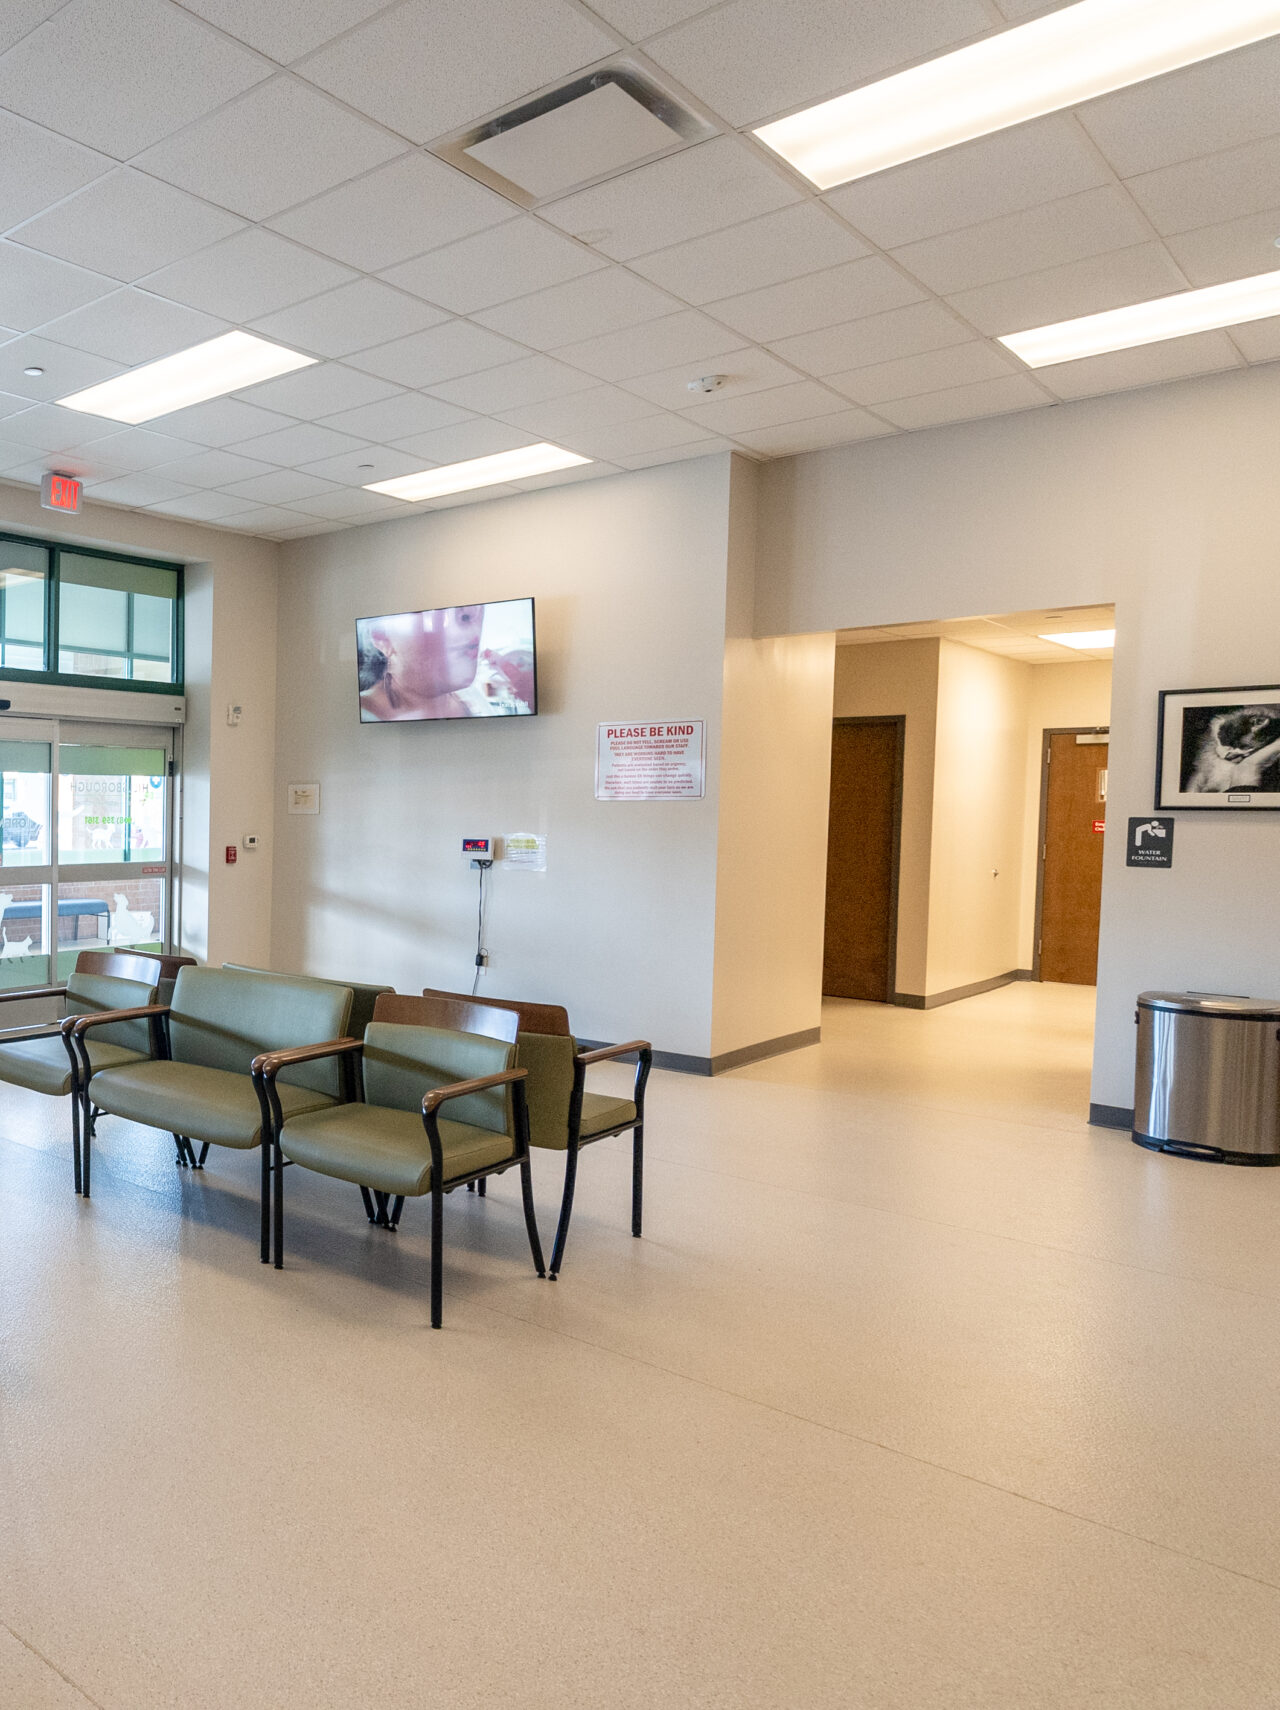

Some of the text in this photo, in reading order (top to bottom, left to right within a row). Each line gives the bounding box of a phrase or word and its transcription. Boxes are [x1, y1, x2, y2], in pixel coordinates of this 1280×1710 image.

[50, 476, 80, 510] EXIT
[607, 725, 694, 738] PLEASE BE KIND
